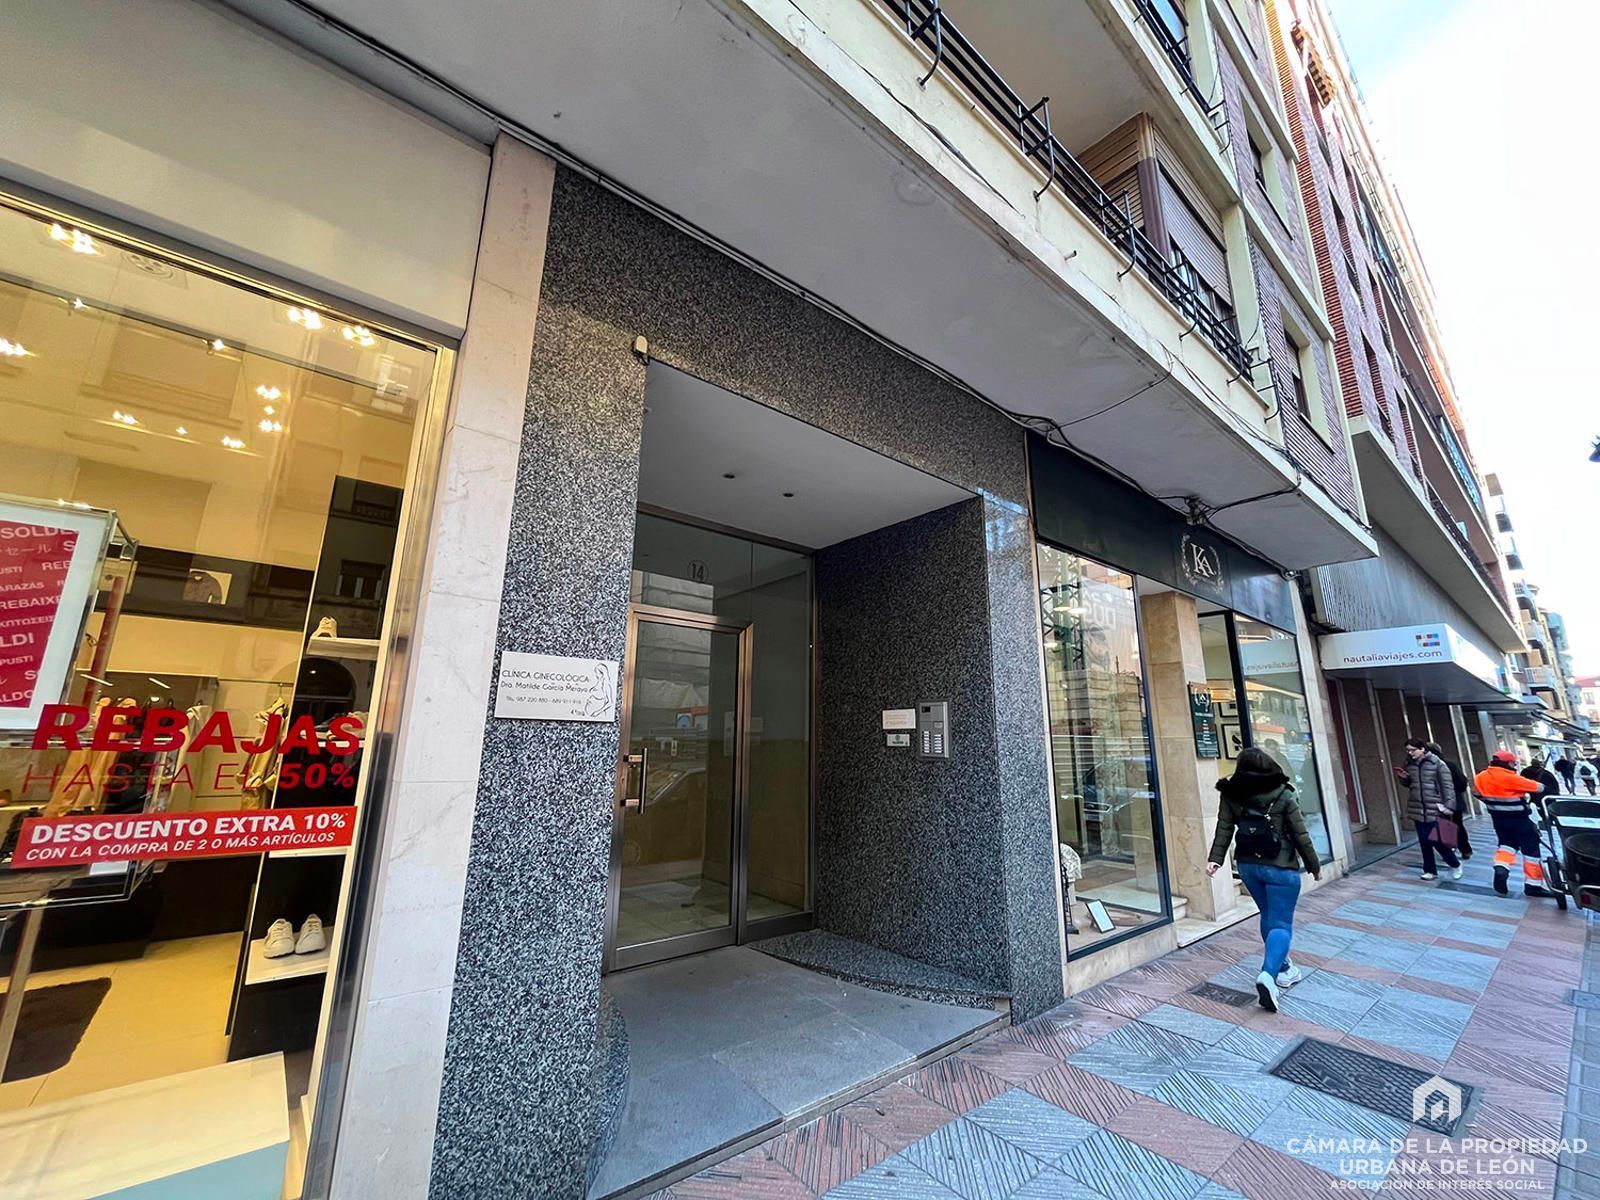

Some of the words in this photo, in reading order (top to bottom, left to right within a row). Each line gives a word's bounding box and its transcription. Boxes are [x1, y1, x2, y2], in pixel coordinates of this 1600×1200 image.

[692, 563, 704, 581] 14
[1343, 650, 1443, 664] nautaliaviajes.com
[32, 704, 363, 755] REBAJAS
[22, 763, 195, 793] HASTA
[278, 762, 355, 790] 50%
[30, 817, 208, 845] DESCUENTO
[213, 814, 296, 835] EXTRA
[25, 846, 67, 861] CON
[69, 846, 93, 858] LA
[97, 841, 168, 856] COMPRA
[173, 839, 196, 851] DE
[197, 839, 209, 850] 2
[224, 834, 259, 848] MÁS
[260, 831, 336, 846] ARTÍCULOS
